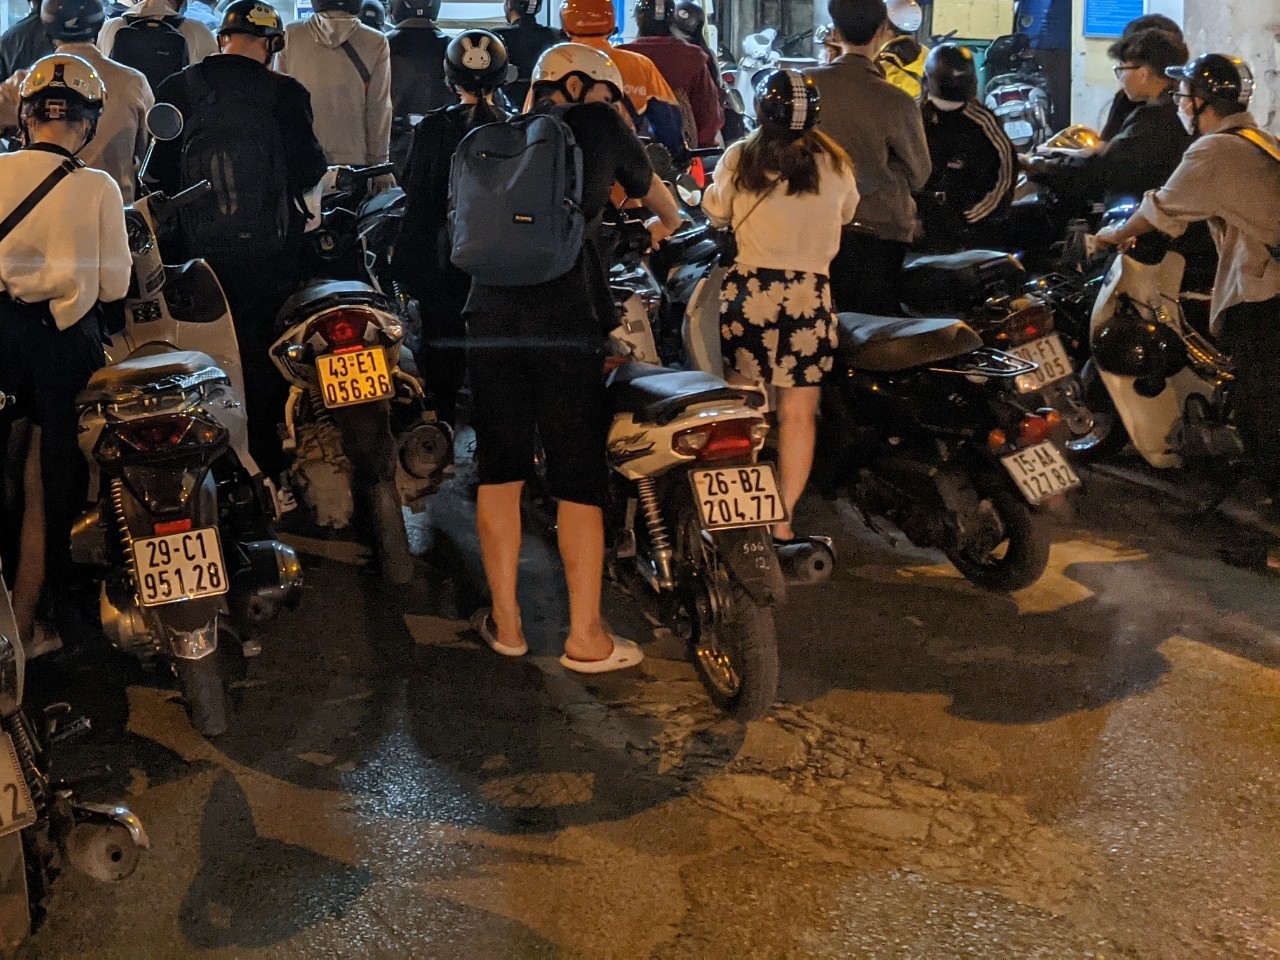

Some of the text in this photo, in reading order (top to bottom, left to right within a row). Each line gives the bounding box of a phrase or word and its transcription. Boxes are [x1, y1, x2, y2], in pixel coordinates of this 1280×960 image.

[328, 352, 377, 378] 43-E1
[326, 374, 390, 403] 056.36
[703, 468, 766, 496] 26-B2
[704, 494, 775, 524] 204.77
[145, 532, 207, 568] 29-C1
[144, 562, 222, 601] 951.28
